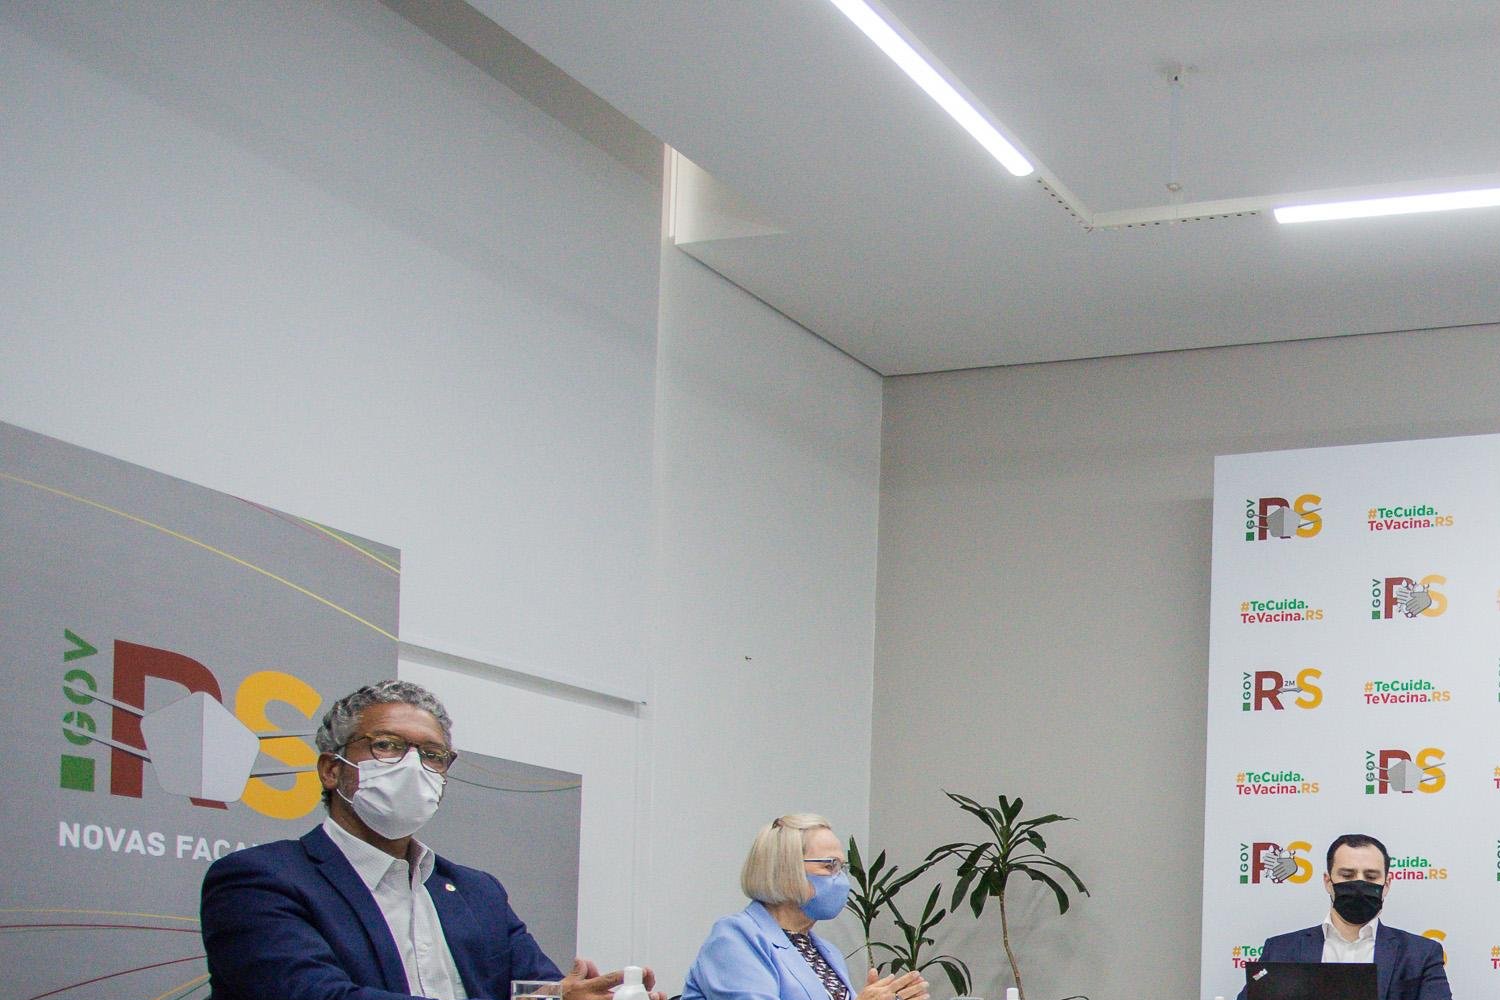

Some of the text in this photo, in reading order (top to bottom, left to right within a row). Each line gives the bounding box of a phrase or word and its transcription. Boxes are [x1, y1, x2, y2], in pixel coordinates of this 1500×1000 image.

[1368, 505, 1438, 519] #TeCuida.
[1368, 516, 1453, 531] TeVacina.RS
[1241, 599, 1308, 612] #TeCuida.
[1240, 610, 1323, 624] TeVacina.RS
[1364, 679, 1435, 692] #TeCuida.
[1364, 691, 1450, 704] TeVacina.RS
[1237, 771, 1304, 783] #TeCuida.
[1236, 783, 1319, 795] TeVacina.RS
[59, 821, 166, 856] NOVAS
